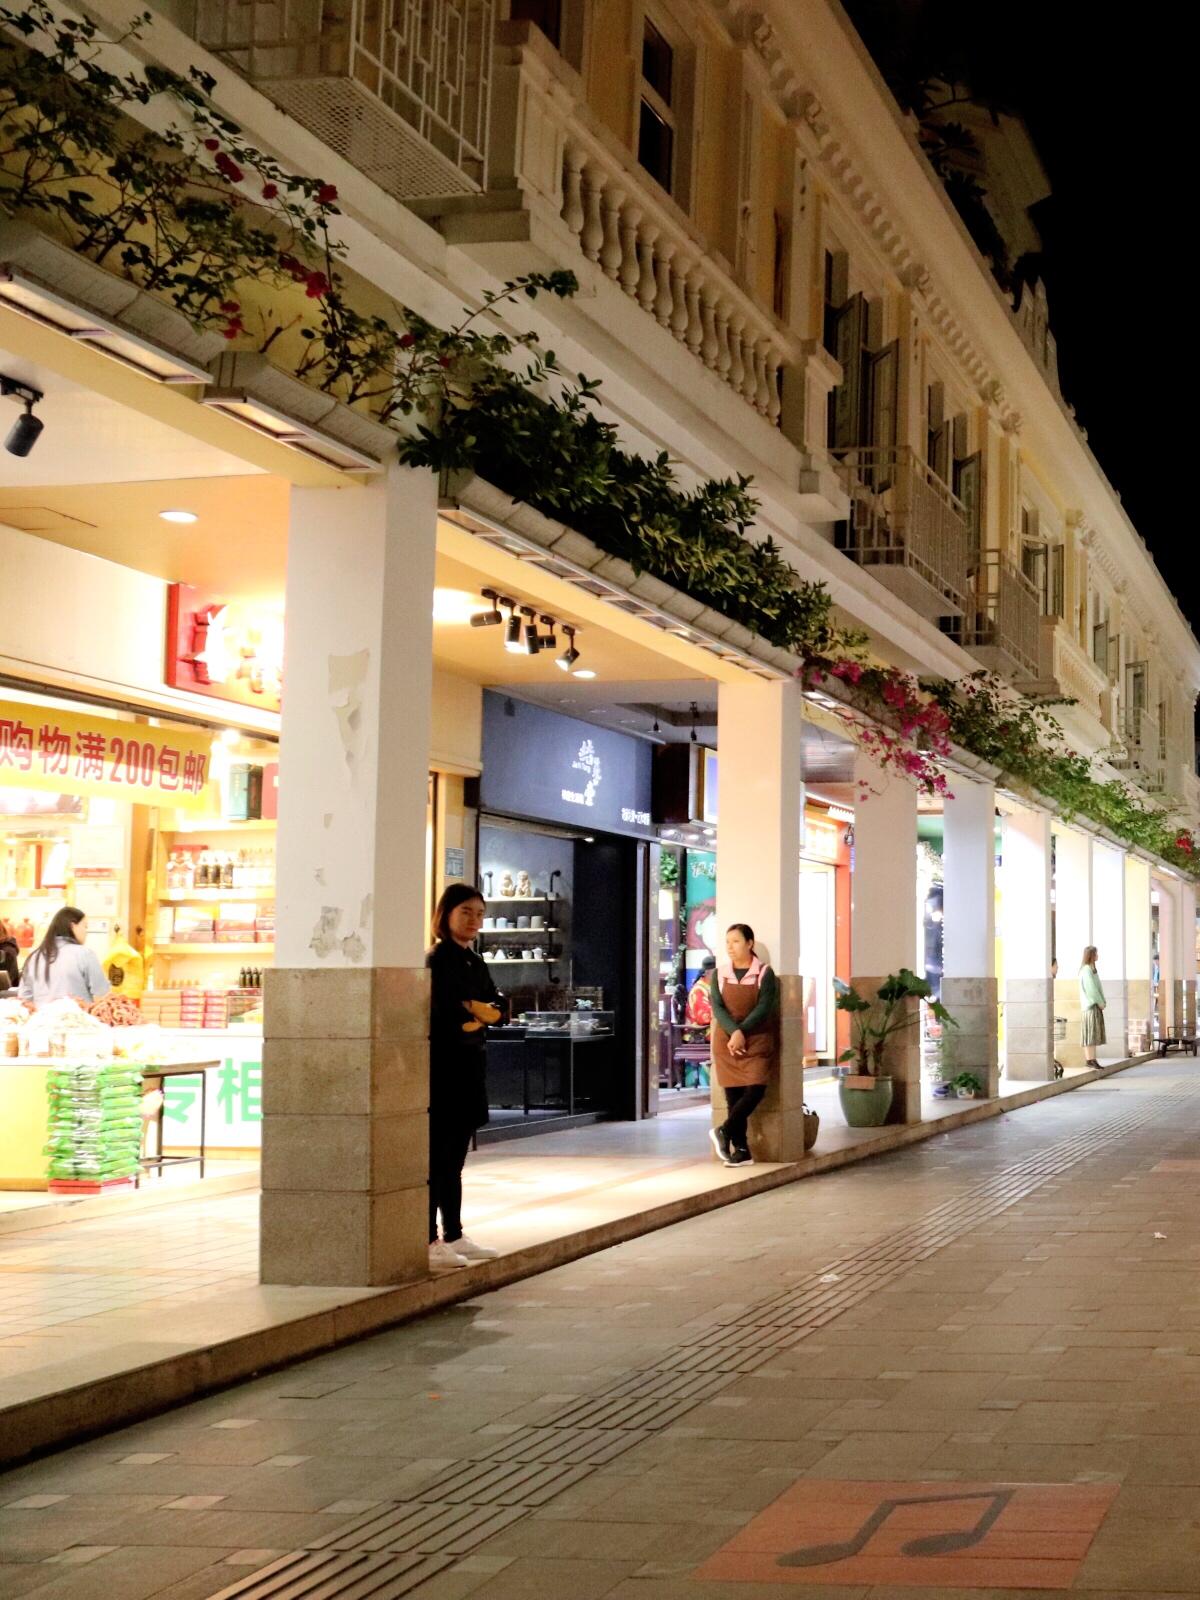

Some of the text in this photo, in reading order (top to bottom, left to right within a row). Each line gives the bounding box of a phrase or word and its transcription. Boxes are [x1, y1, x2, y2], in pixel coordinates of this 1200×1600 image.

[0, 719, 207, 795] 购物满200包邮
